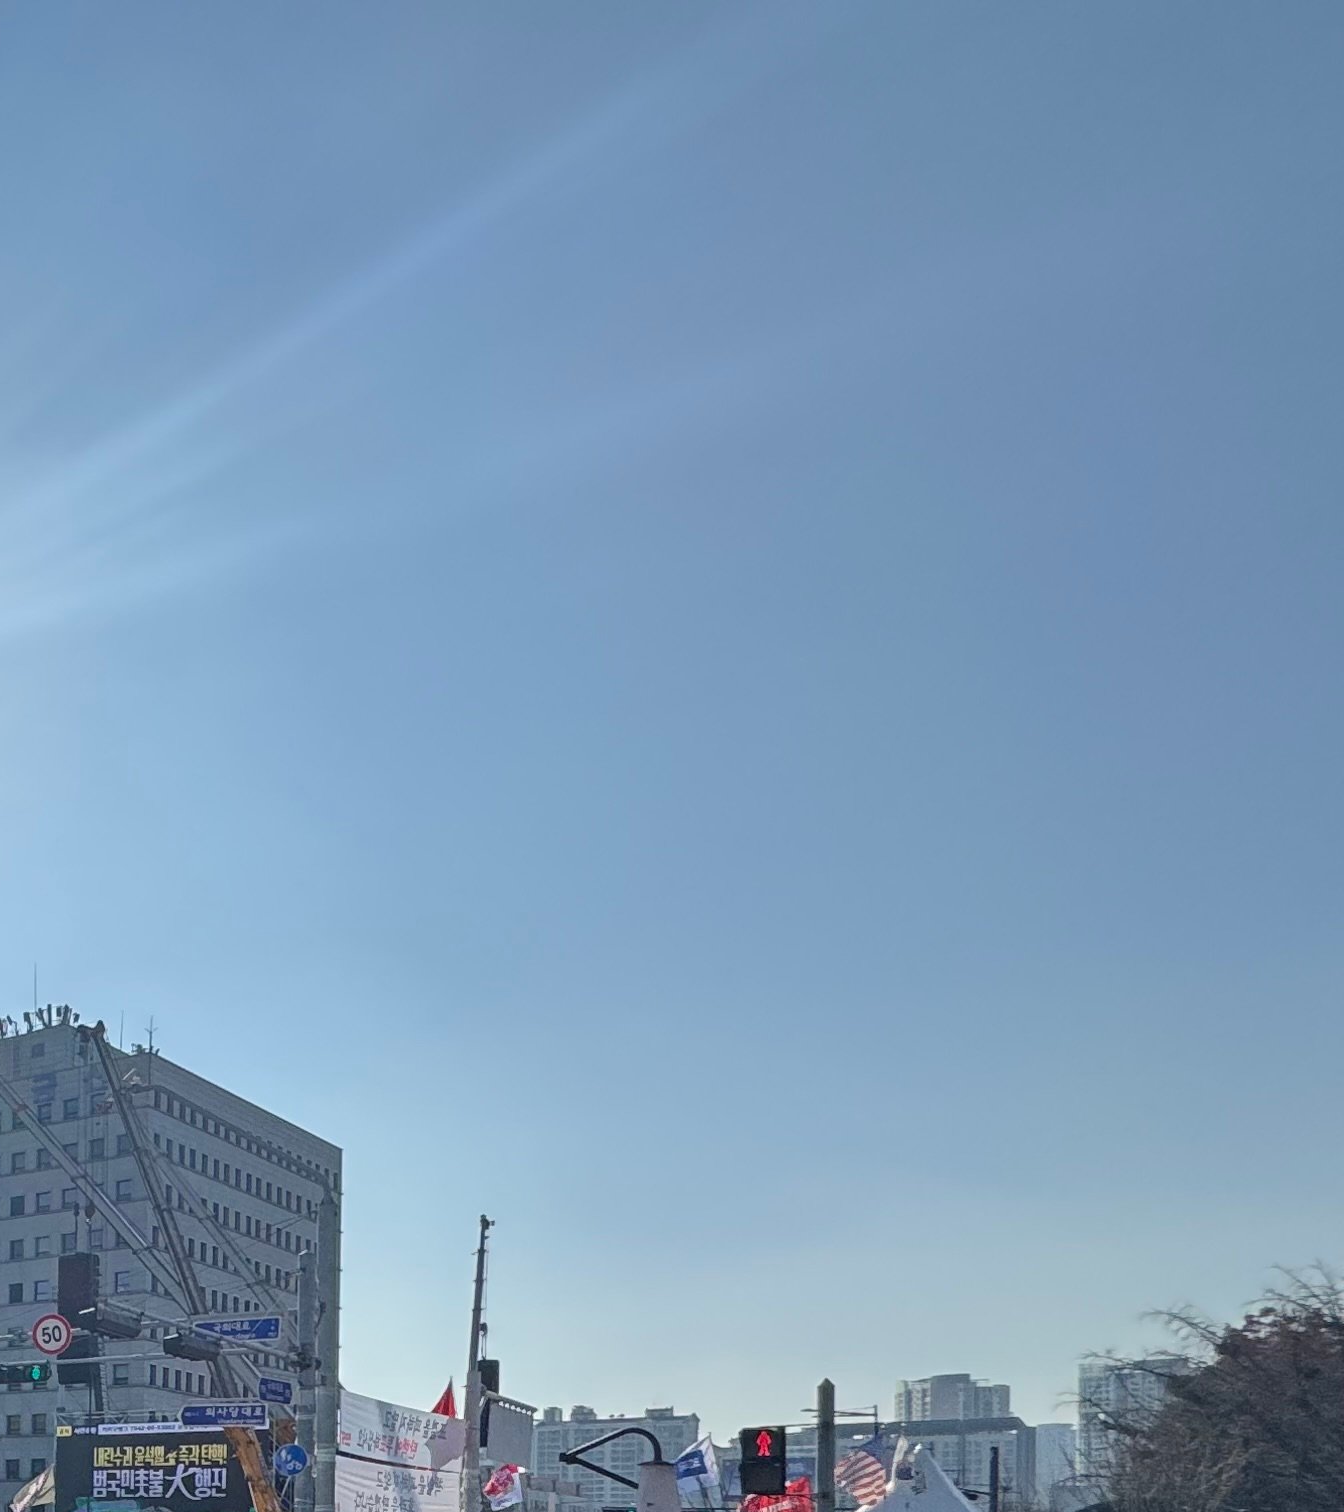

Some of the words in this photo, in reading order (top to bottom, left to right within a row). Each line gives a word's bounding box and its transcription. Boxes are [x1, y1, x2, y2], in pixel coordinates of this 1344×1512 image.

[41, 1325, 63, 1344] 50
[205, 1406, 264, 1418] 의사당대로
[93, 1446, 133, 1468] 내란수괴
[134, 1445, 165, 1467] 윤석열
[179, 1444, 200, 1466] 즉각
[201, 1443, 228, 1465] 탄핵!
